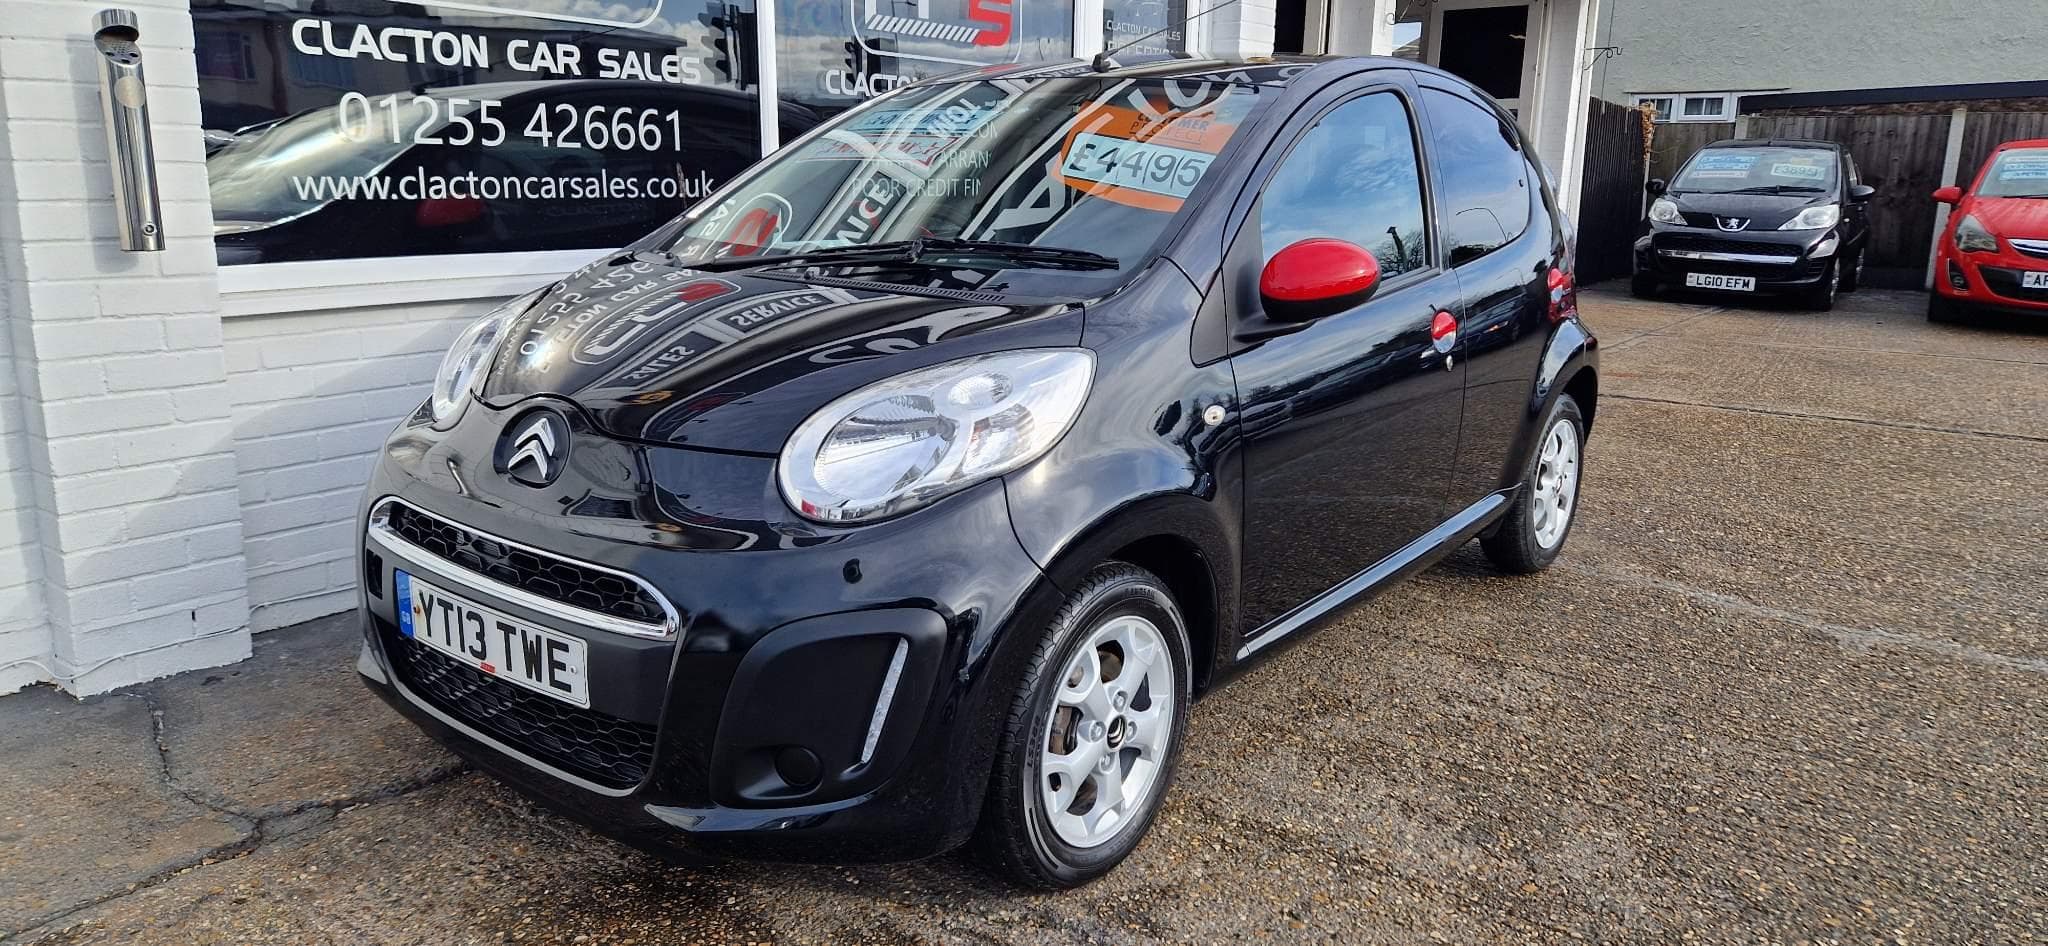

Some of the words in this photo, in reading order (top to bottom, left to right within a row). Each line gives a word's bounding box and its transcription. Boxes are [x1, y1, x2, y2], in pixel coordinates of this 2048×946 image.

[292, 18, 489, 69] CLACTON
[506, 38, 582, 76] CAR
[599, 47, 701, 84] SALES
[825, 69, 918, 97] CLACTO
[339, 91, 506, 147] 01255
[523, 102, 683, 151] 426661
[292, 165, 715, 201] www.clactoncarsales.co.uk
[1069, 142, 1207, 187] £4495
[904, 177, 959, 198] CREDIT
[1725, 277, 1751, 290] EFM
[418, 590, 487, 661] YT13
[496, 621, 572, 693] TWE
